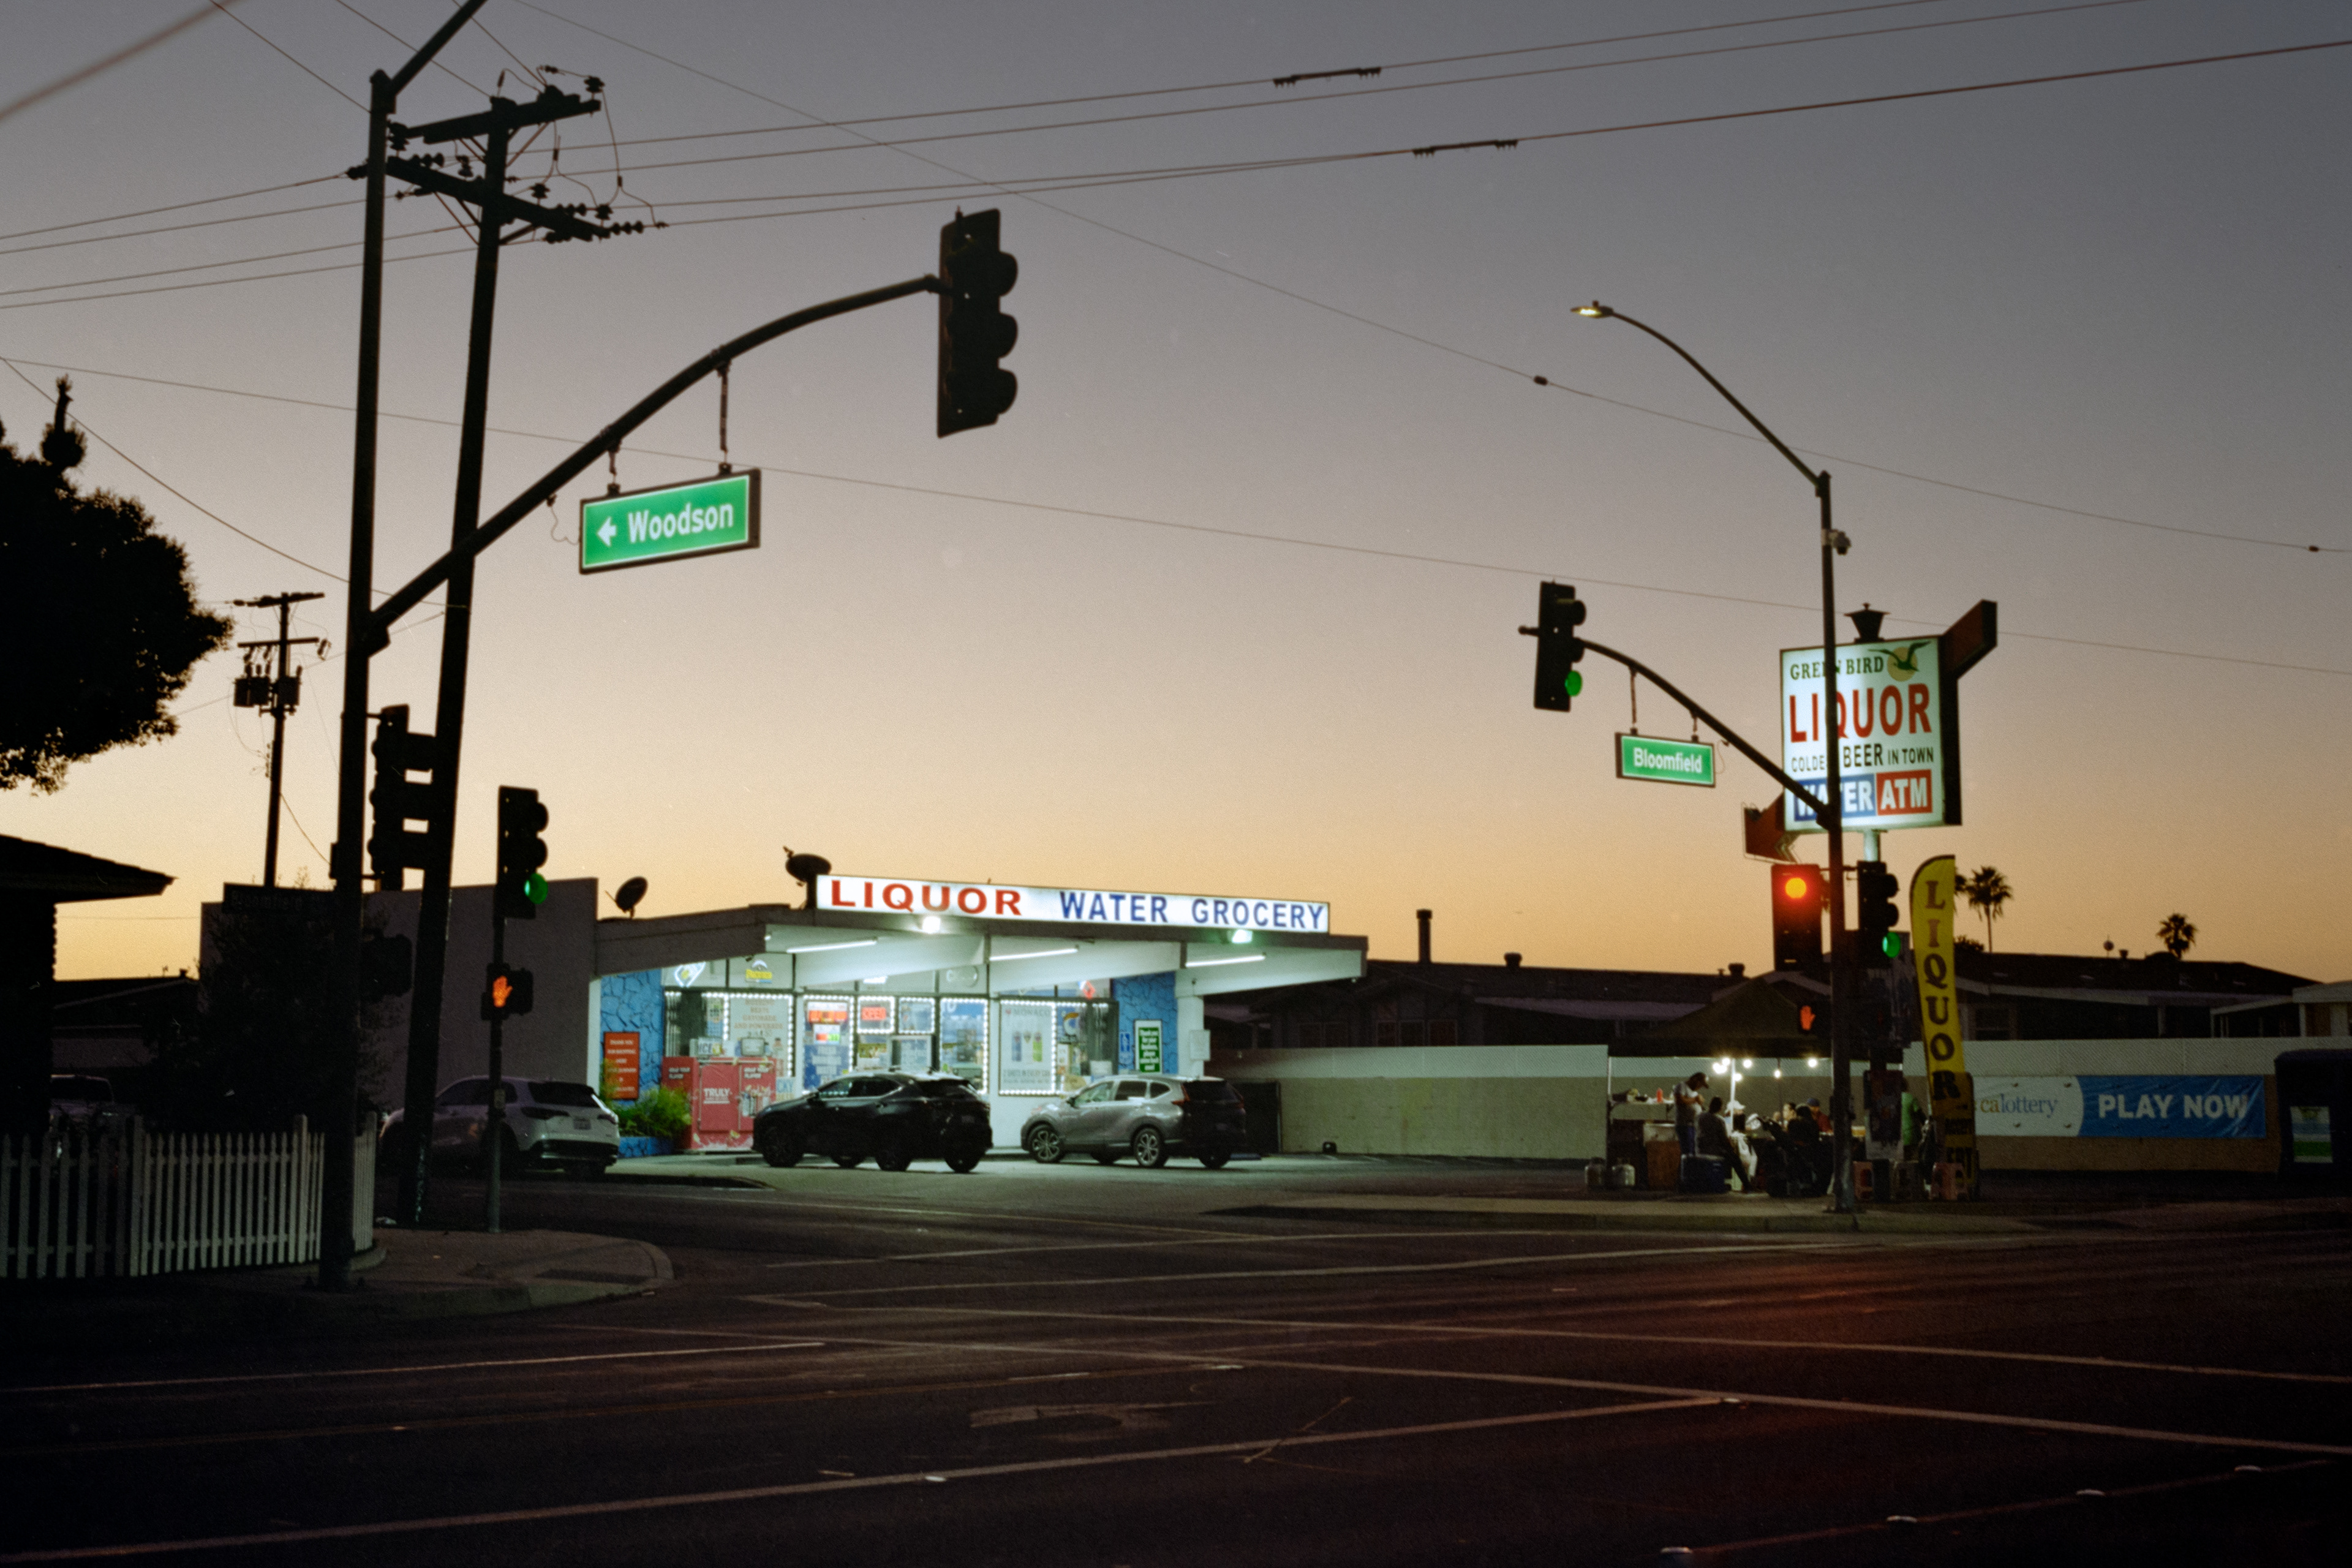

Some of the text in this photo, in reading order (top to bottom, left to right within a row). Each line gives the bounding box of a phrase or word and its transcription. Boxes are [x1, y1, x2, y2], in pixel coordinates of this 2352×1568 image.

[628, 502, 733, 544] Woodson
[1790, 656, 1884, 680] GRE BIRD
[1634, 747, 1702, 774] Bloomfield
[1792, 743, 1934, 772] COLDE BEER IN TOWN
[1880, 777, 1928, 810] ATM
[831, 880, 1324, 929] LIQUOR WATER GROCERY
[1923, 880, 1961, 1101] LIQUOR
[703, 1088, 730, 1097] TRULY
[2098, 1095, 2249, 1118] PLAY NOW
